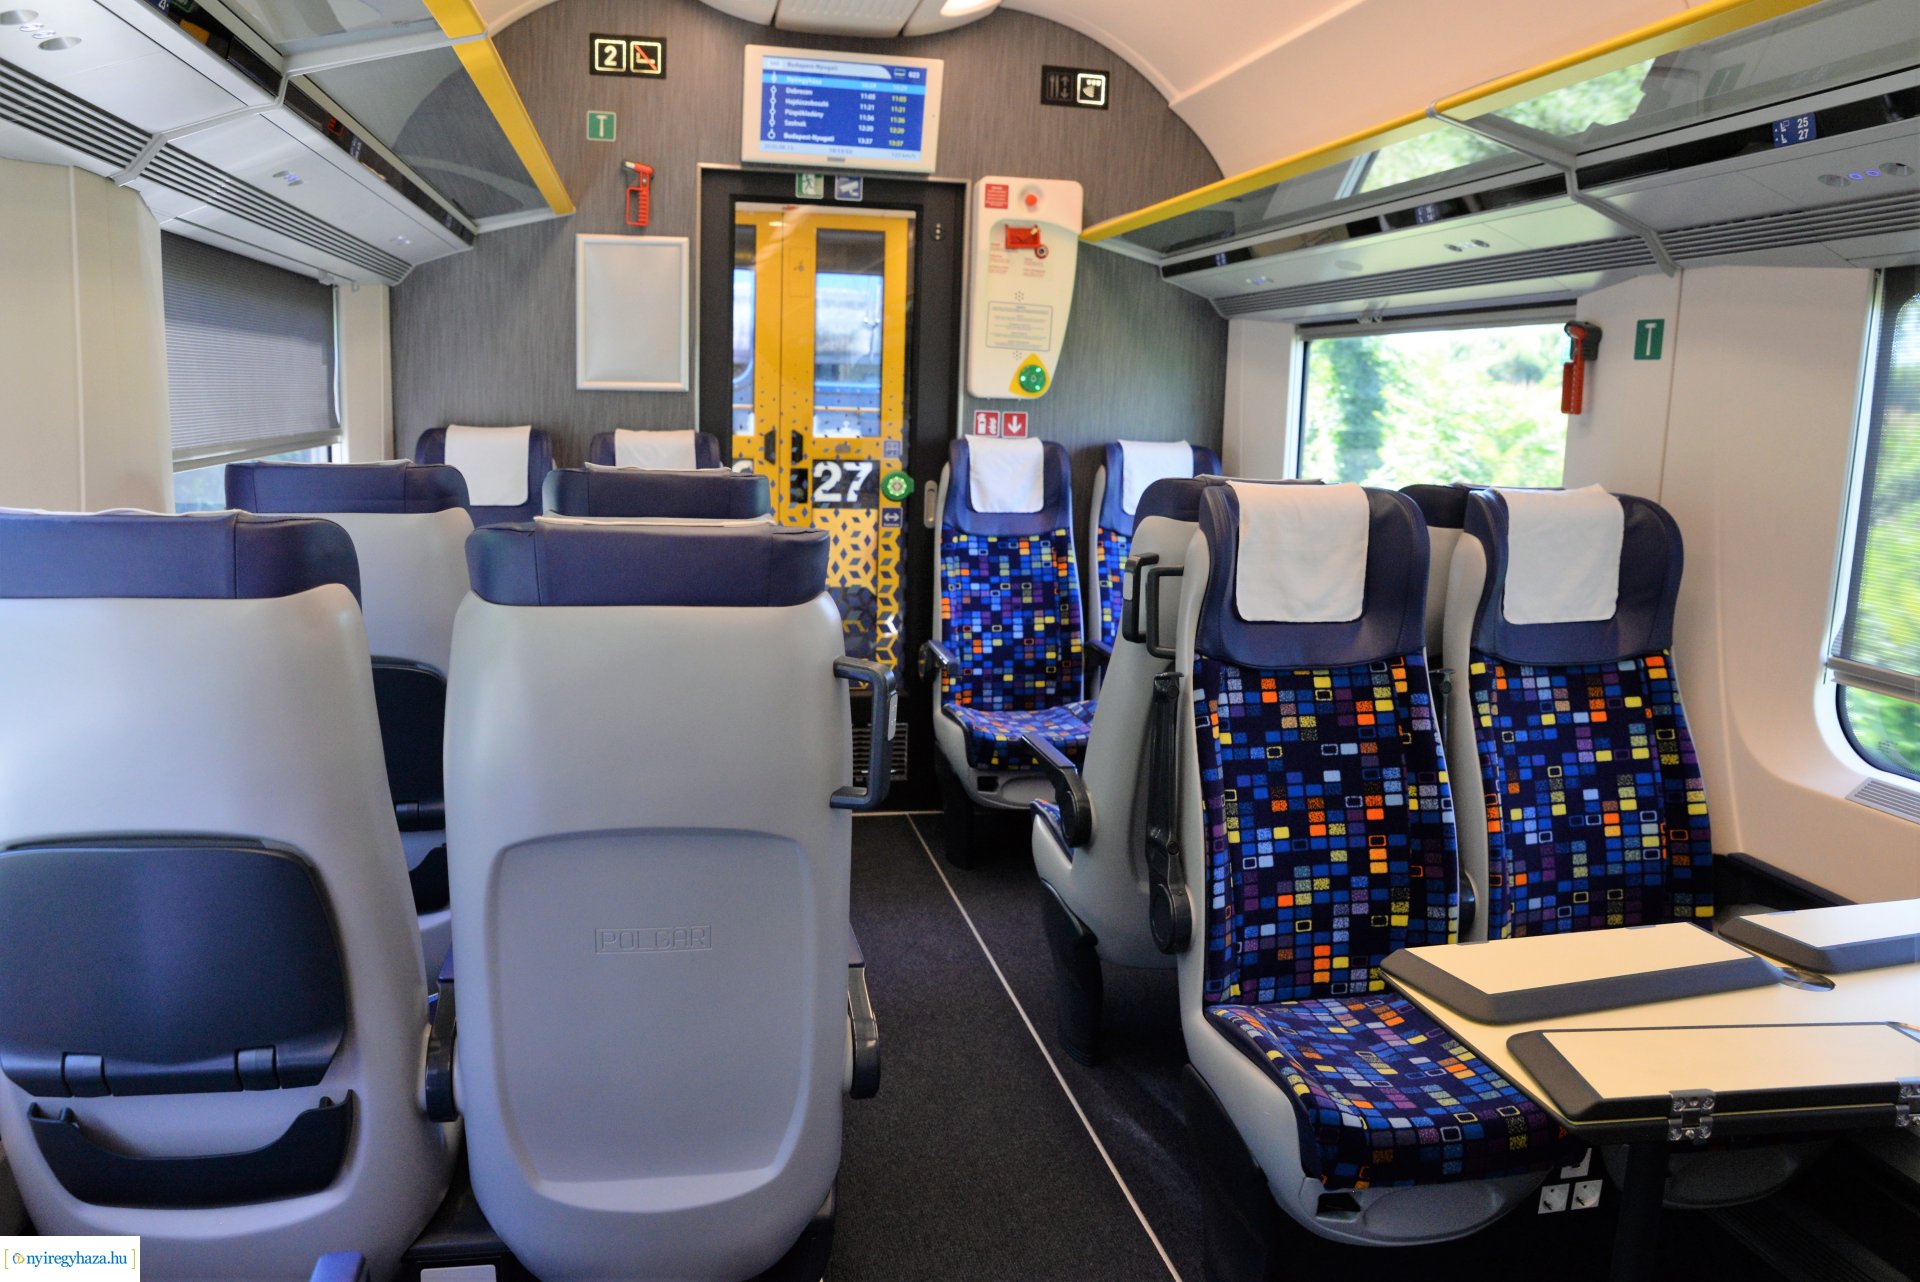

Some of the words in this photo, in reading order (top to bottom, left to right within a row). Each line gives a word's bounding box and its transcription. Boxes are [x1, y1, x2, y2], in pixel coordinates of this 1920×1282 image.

[604, 45, 618, 67] 2
[1797, 116, 1809, 129] 25
[1798, 128, 1810, 141] 27
[813, 461, 873, 503] 27
